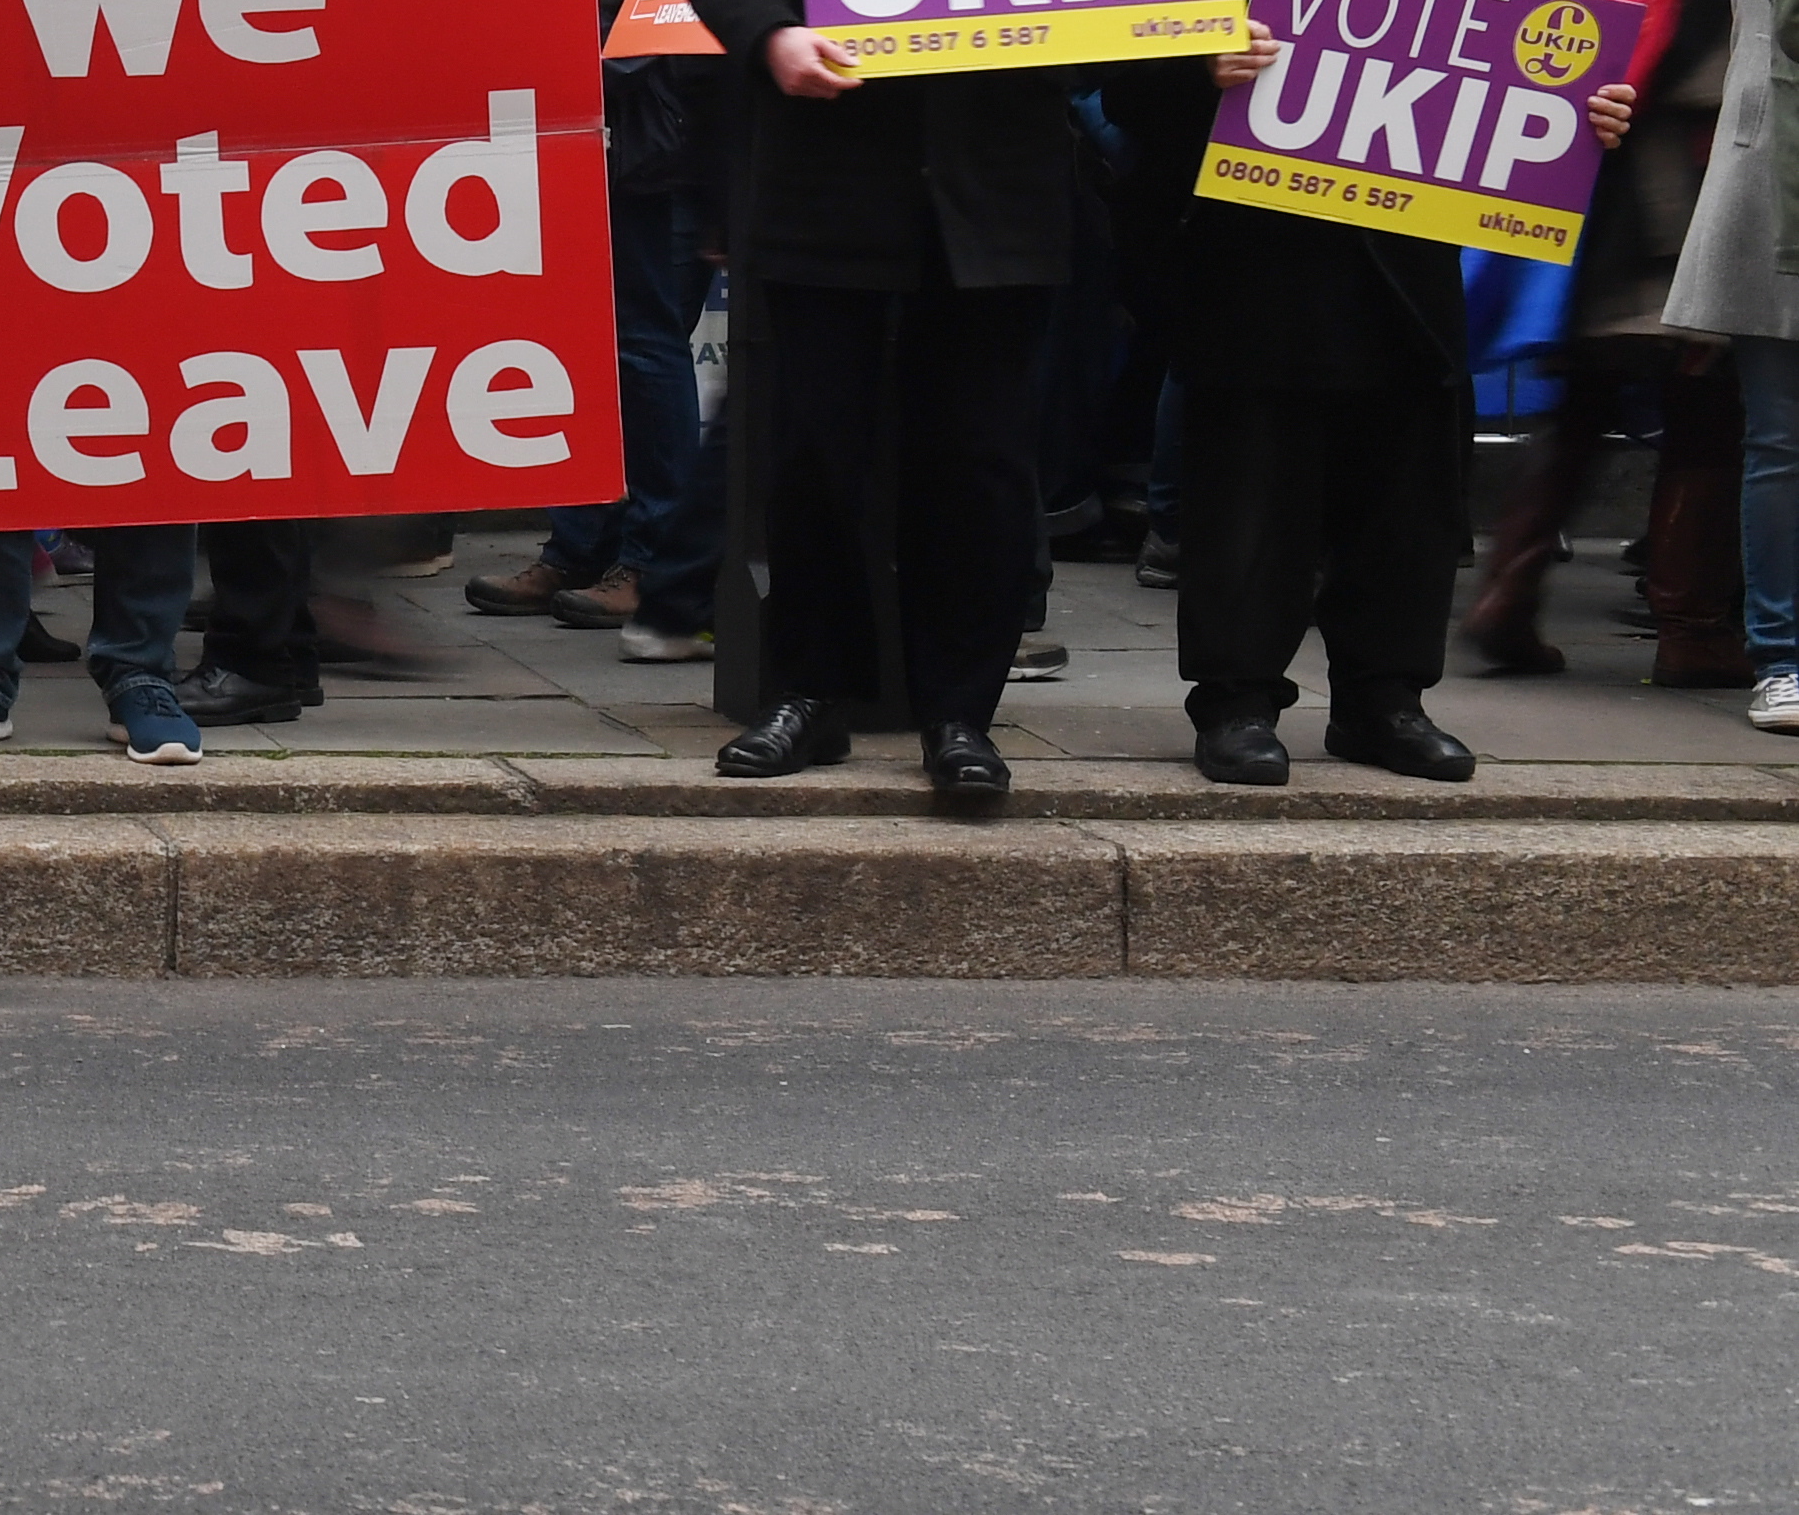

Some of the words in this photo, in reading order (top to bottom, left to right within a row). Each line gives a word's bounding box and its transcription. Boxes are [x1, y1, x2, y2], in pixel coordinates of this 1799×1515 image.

[909, 30, 959, 53] 587
[970, 28, 988, 49] 6
[998, 24, 1051, 47] 587
[1130, 15, 1235, 41] ukip.org
[1519, 26, 1596, 55] UKIP
[1247, 40, 1579, 191] UKIP
[1215, 158, 1281, 188] 0800
[1288, 171, 1336, 199] 587
[1342, 182, 1357, 203] 6
[1365, 188, 1414, 213] 587
[1478, 210, 1568, 246] ukip.org
